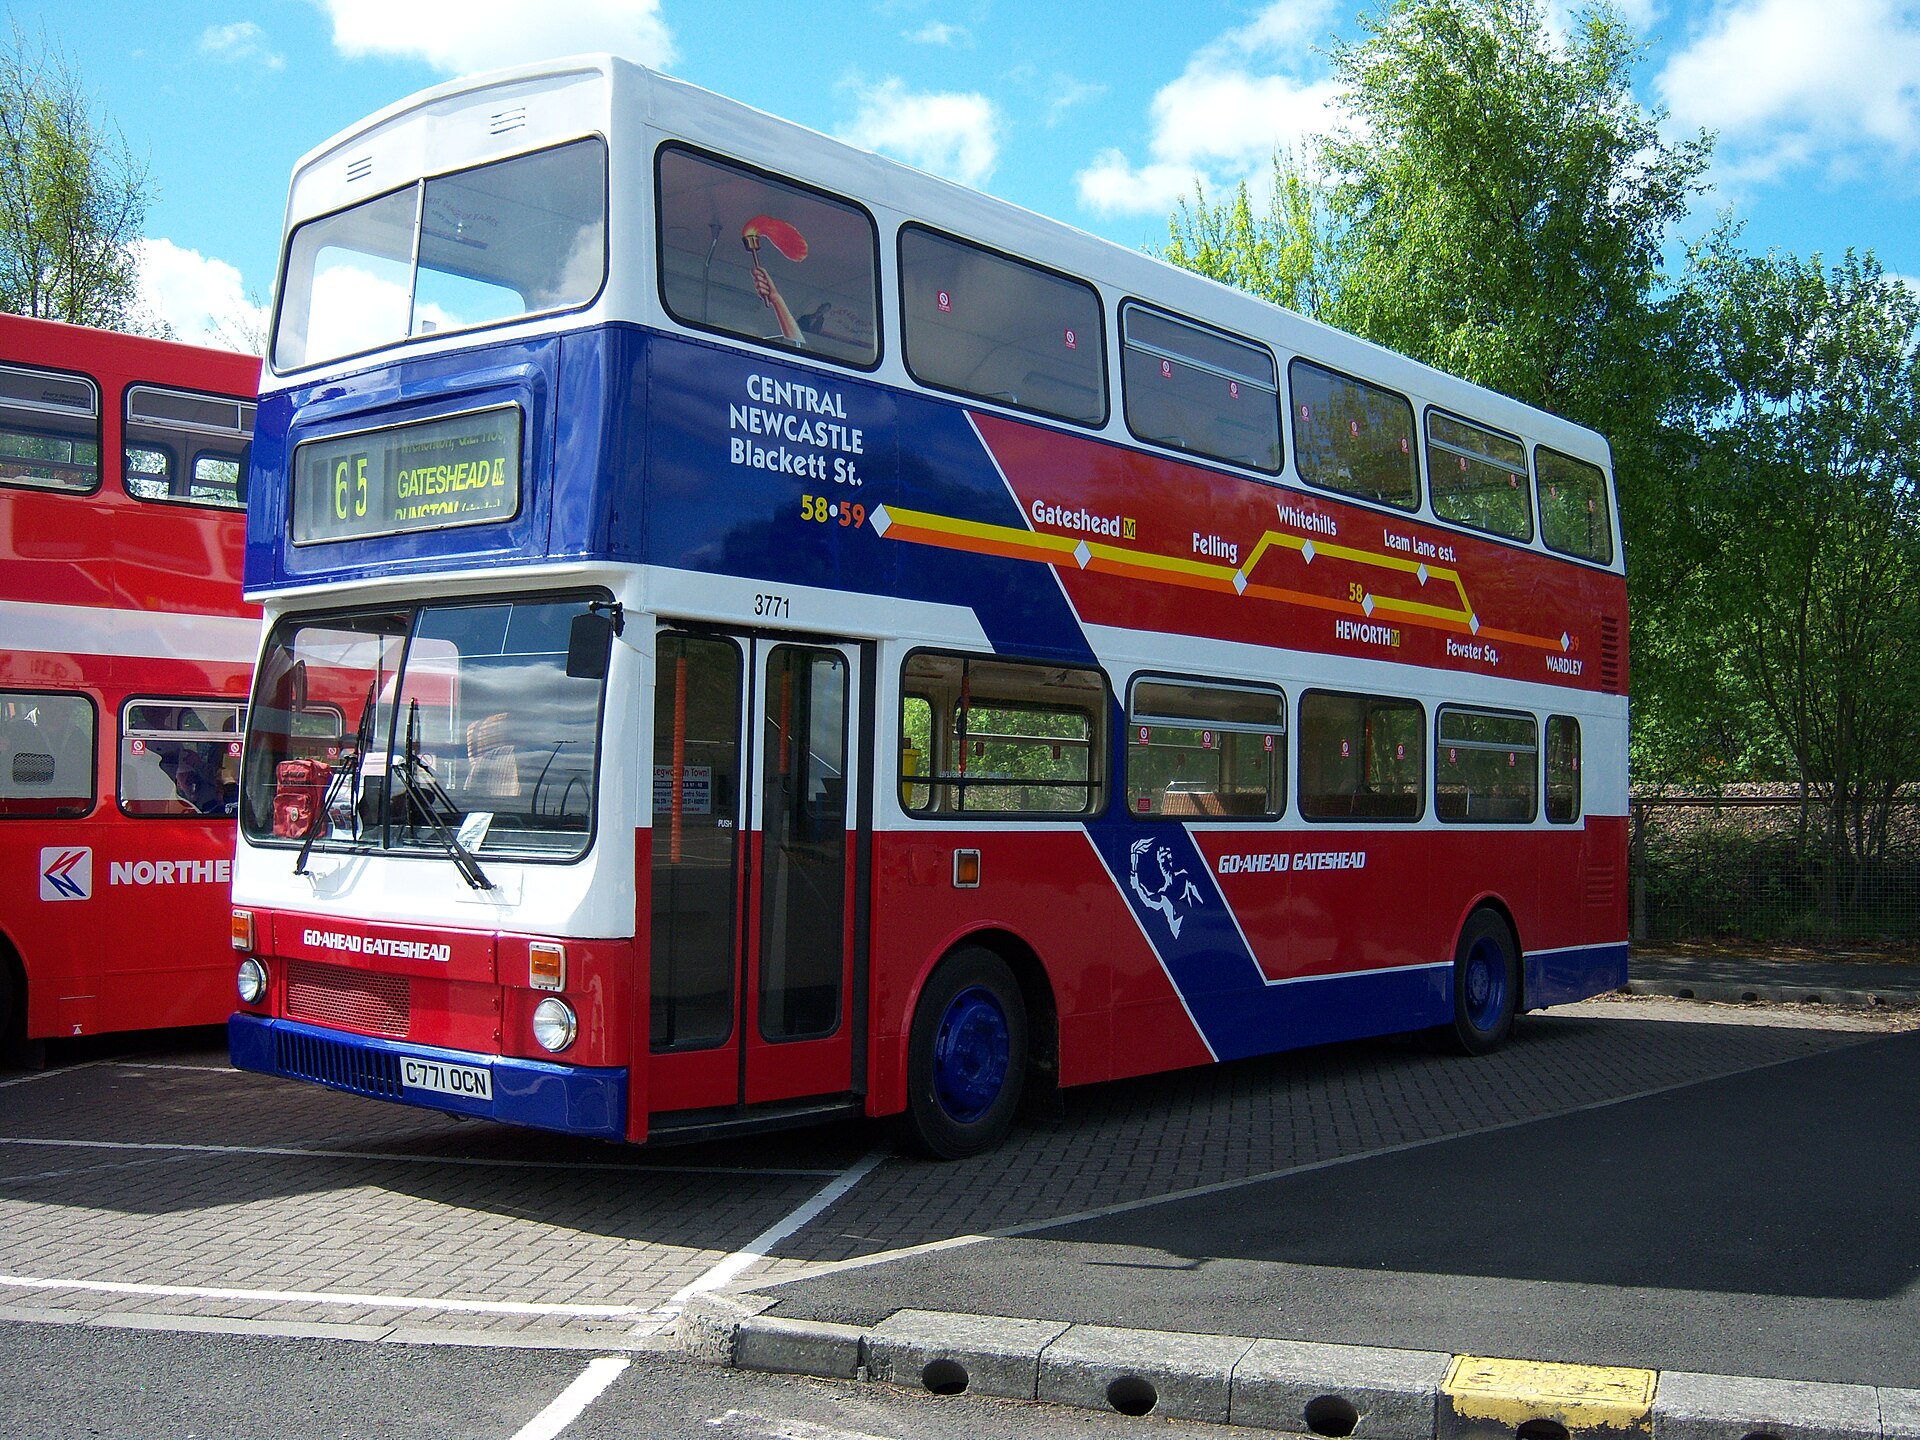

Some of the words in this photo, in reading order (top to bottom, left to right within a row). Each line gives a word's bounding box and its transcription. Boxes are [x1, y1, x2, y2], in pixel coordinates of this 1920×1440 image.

[746, 374, 847, 419] CENTRAL
[730, 403, 863, 454] NEWCASTLE
[730, 437, 827, 480] Blackett
[834, 457, 863, 486] St.
[335, 458, 368, 519] 65
[397, 460, 490, 499] GATESHEAD
[1031, 499, 1120, 537] Gateshead
[1276, 504, 1337, 536] Whitehills
[1192, 532, 1238, 564] Felling
[1383, 529, 1411, 552] Leam
[1412, 536, 1436, 558] Lane
[1438, 545, 1457, 563] est.
[754, 594, 790, 618] 3771
[1348, 582, 1363, 603] 58
[1335, 619, 1391, 646] HEWORTH
[1570, 635, 1580, 651] 59
[1446, 638, 1482, 660] Fewster
[1483, 645, 1499, 666] Sq.
[1545, 655, 1582, 676] WARDLEY
[718, 819, 732, 828] PUSH
[110, 860, 234, 885] NORTHE
[1292, 851, 1366, 871] GATESHEAD
[362, 937, 451, 962] GATESHEAD
[405, 1061, 446, 1089] C771
[449, 1068, 487, 1096] OCN
